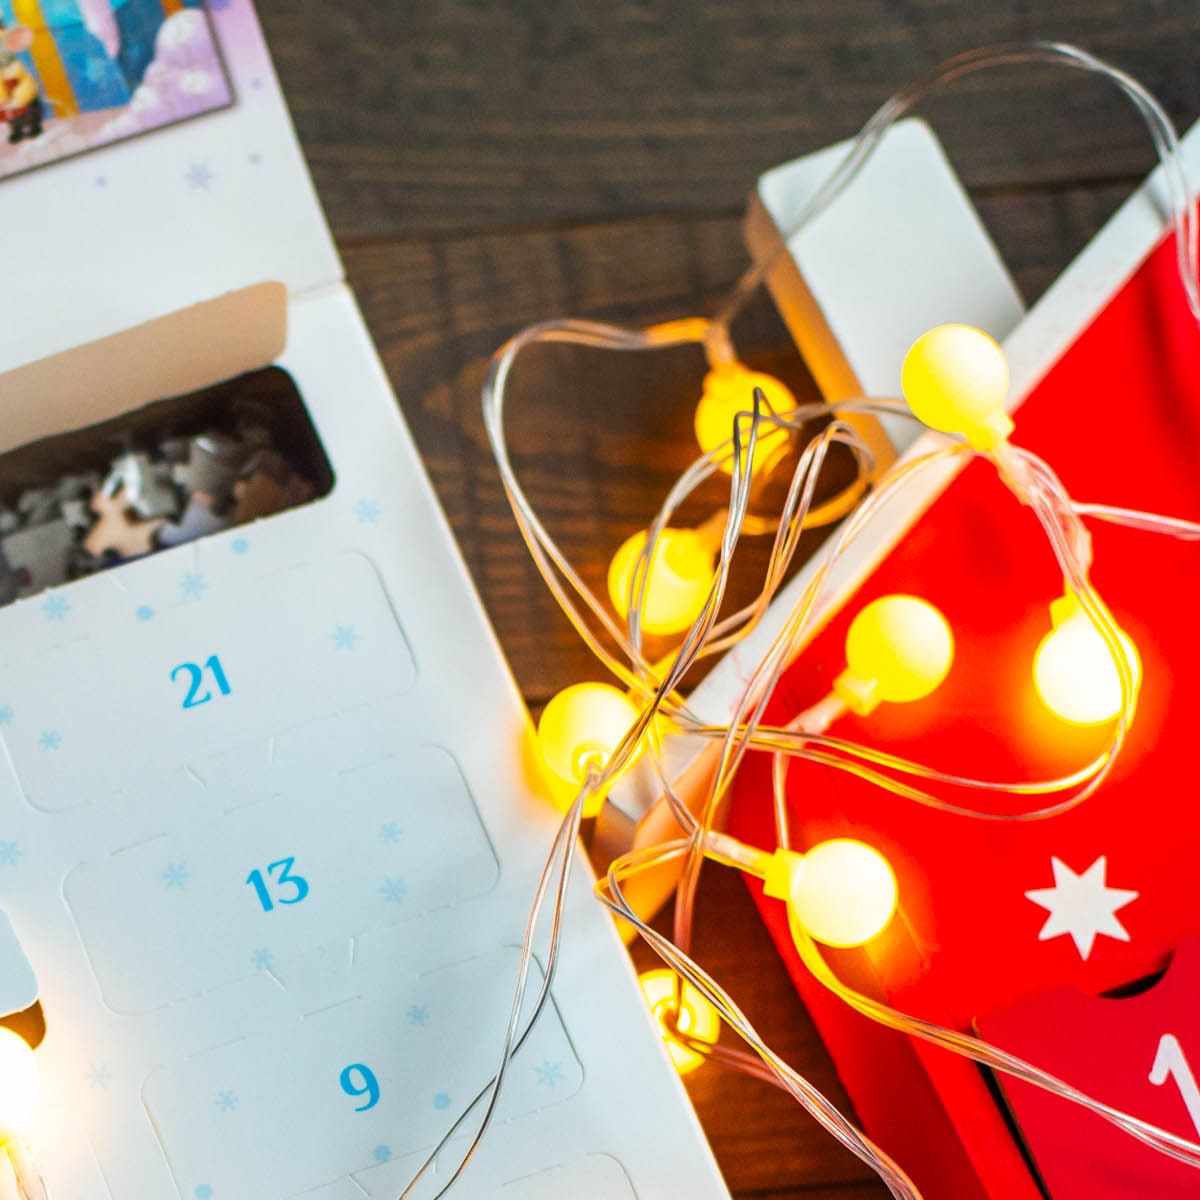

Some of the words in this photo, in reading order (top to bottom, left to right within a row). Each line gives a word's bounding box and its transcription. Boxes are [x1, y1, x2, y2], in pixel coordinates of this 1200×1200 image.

[170, 654, 232, 710] 21
[245, 856, 310, 913] 13
[339, 1062, 381, 1113] 9
